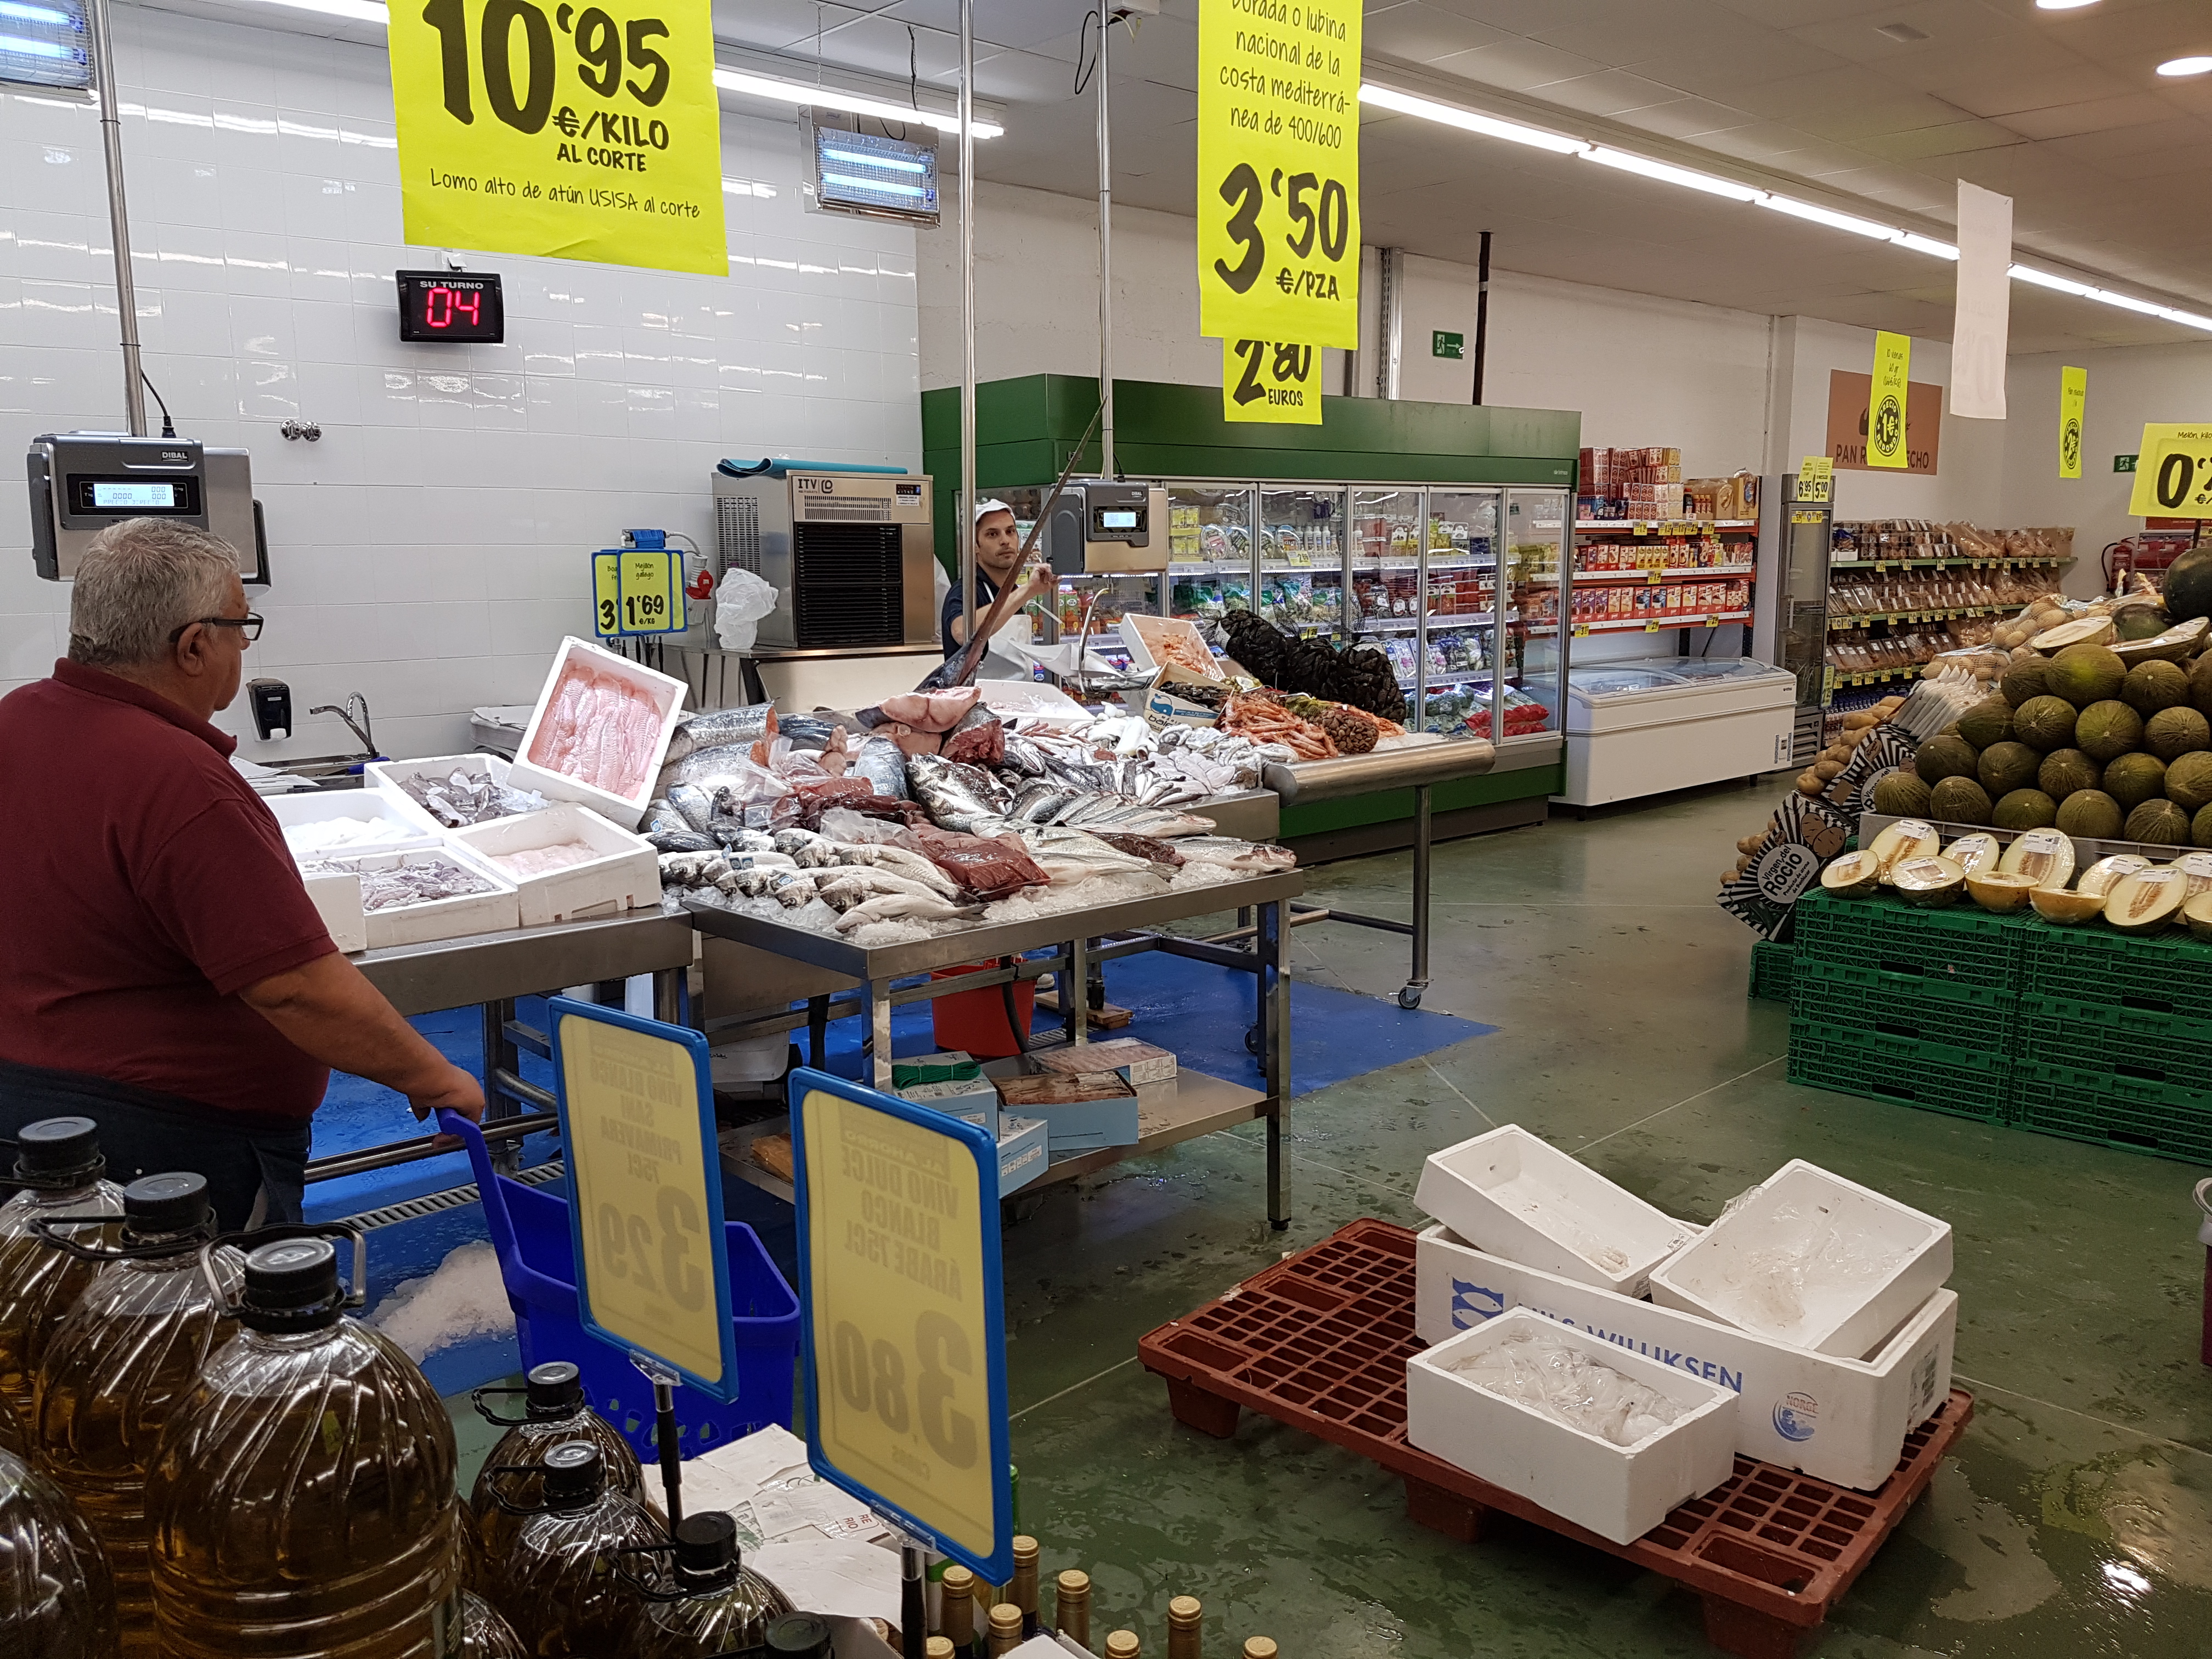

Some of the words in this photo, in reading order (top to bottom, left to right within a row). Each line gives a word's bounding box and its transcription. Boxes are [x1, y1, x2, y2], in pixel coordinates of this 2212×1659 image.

[1293, 8, 1301, 27] o
[1306, 6, 1346, 42] lubina
[1236, 31, 1300, 65] nacional
[1306, 45, 1323, 70] de
[1329, 50, 1340, 77] la
[1220, 66, 1265, 95] costa
[552, 106, 669, 150] €/KILO
[1231, 107, 1259, 132] nea
[1265, 110, 1283, 134] de
[1289, 116, 1341, 149] 400/600
[556, 143, 582, 164] AL
[587, 146, 647, 172] CORTE
[431, 168, 478, 191] Lomo
[484, 176, 515, 196] alto
[523, 182, 541, 199] de
[549, 185, 584, 205] atún
[589, 188, 639, 211] USISA
[644, 196, 656, 213] al
[661, 200, 700, 218] corte
[1276, 267, 1340, 301] €/PZA
[426, 287, 481, 328] 04
[1268, 388, 1304, 407] EUROS
[1880, 400, 1897, 417] PRECIO
[1836, 444, 1857, 464] PAN
[1876, 428, 1898, 452] REDONDO
[162, 451, 188, 460] DIBAL
[798, 478, 817, 489] ITV
[1780, 845, 1791, 858] del
[1763, 853, 1802, 896] ROCIO
